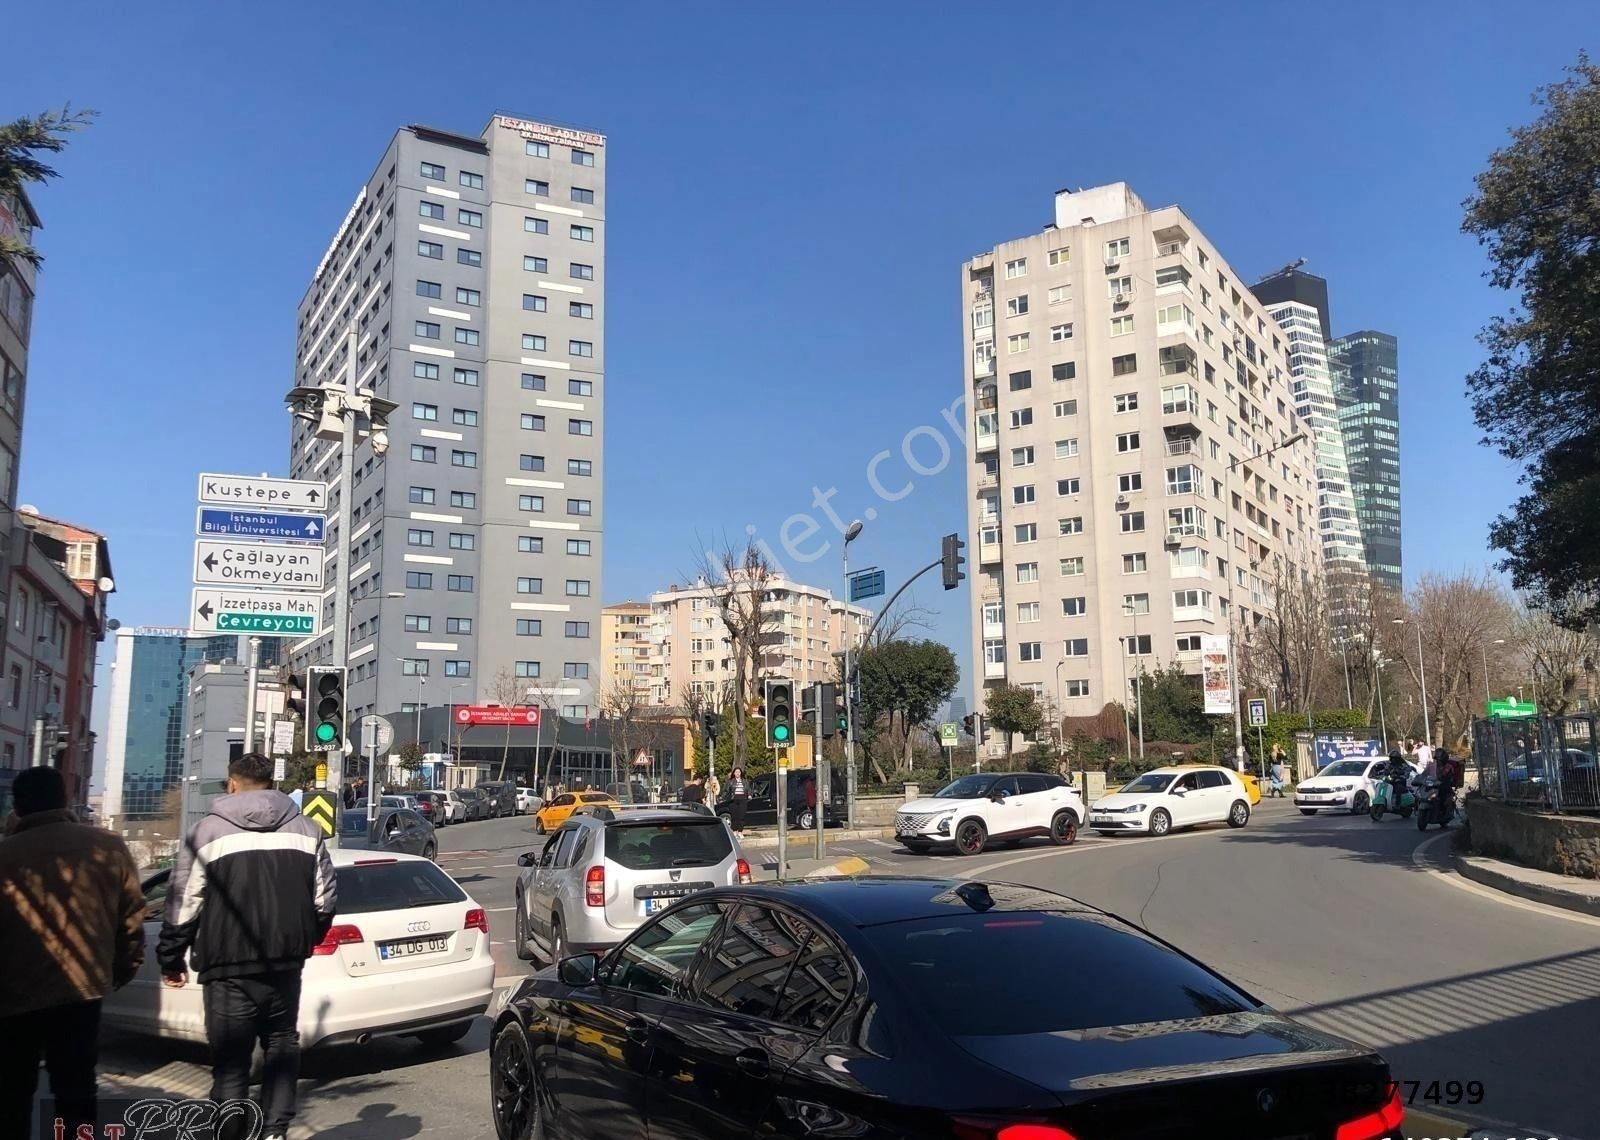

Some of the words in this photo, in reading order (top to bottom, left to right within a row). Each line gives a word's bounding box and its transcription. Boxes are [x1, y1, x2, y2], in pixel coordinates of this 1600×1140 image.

[207, 482, 291, 501] Kuştepe
[230, 512, 278, 524] İstanbul
[204, 522, 230, 534] Bilgi
[233, 523, 300, 536] Üniversitesi
[222, 549, 309, 567] Çağlayan
[221, 566, 318, 583] Okmeydanı
[219, 592, 282, 613] İzzetpaşa
[287, 599, 317, 613] Mah.
[218, 613, 312, 631] Çevreyolu
[652, 888, 698, 896] DUSTER
[652, 901, 663, 911] 34
[389, 943, 402, 956] 34
[407, 941, 423, 953] DG
[428, 938, 445, 950] 013
